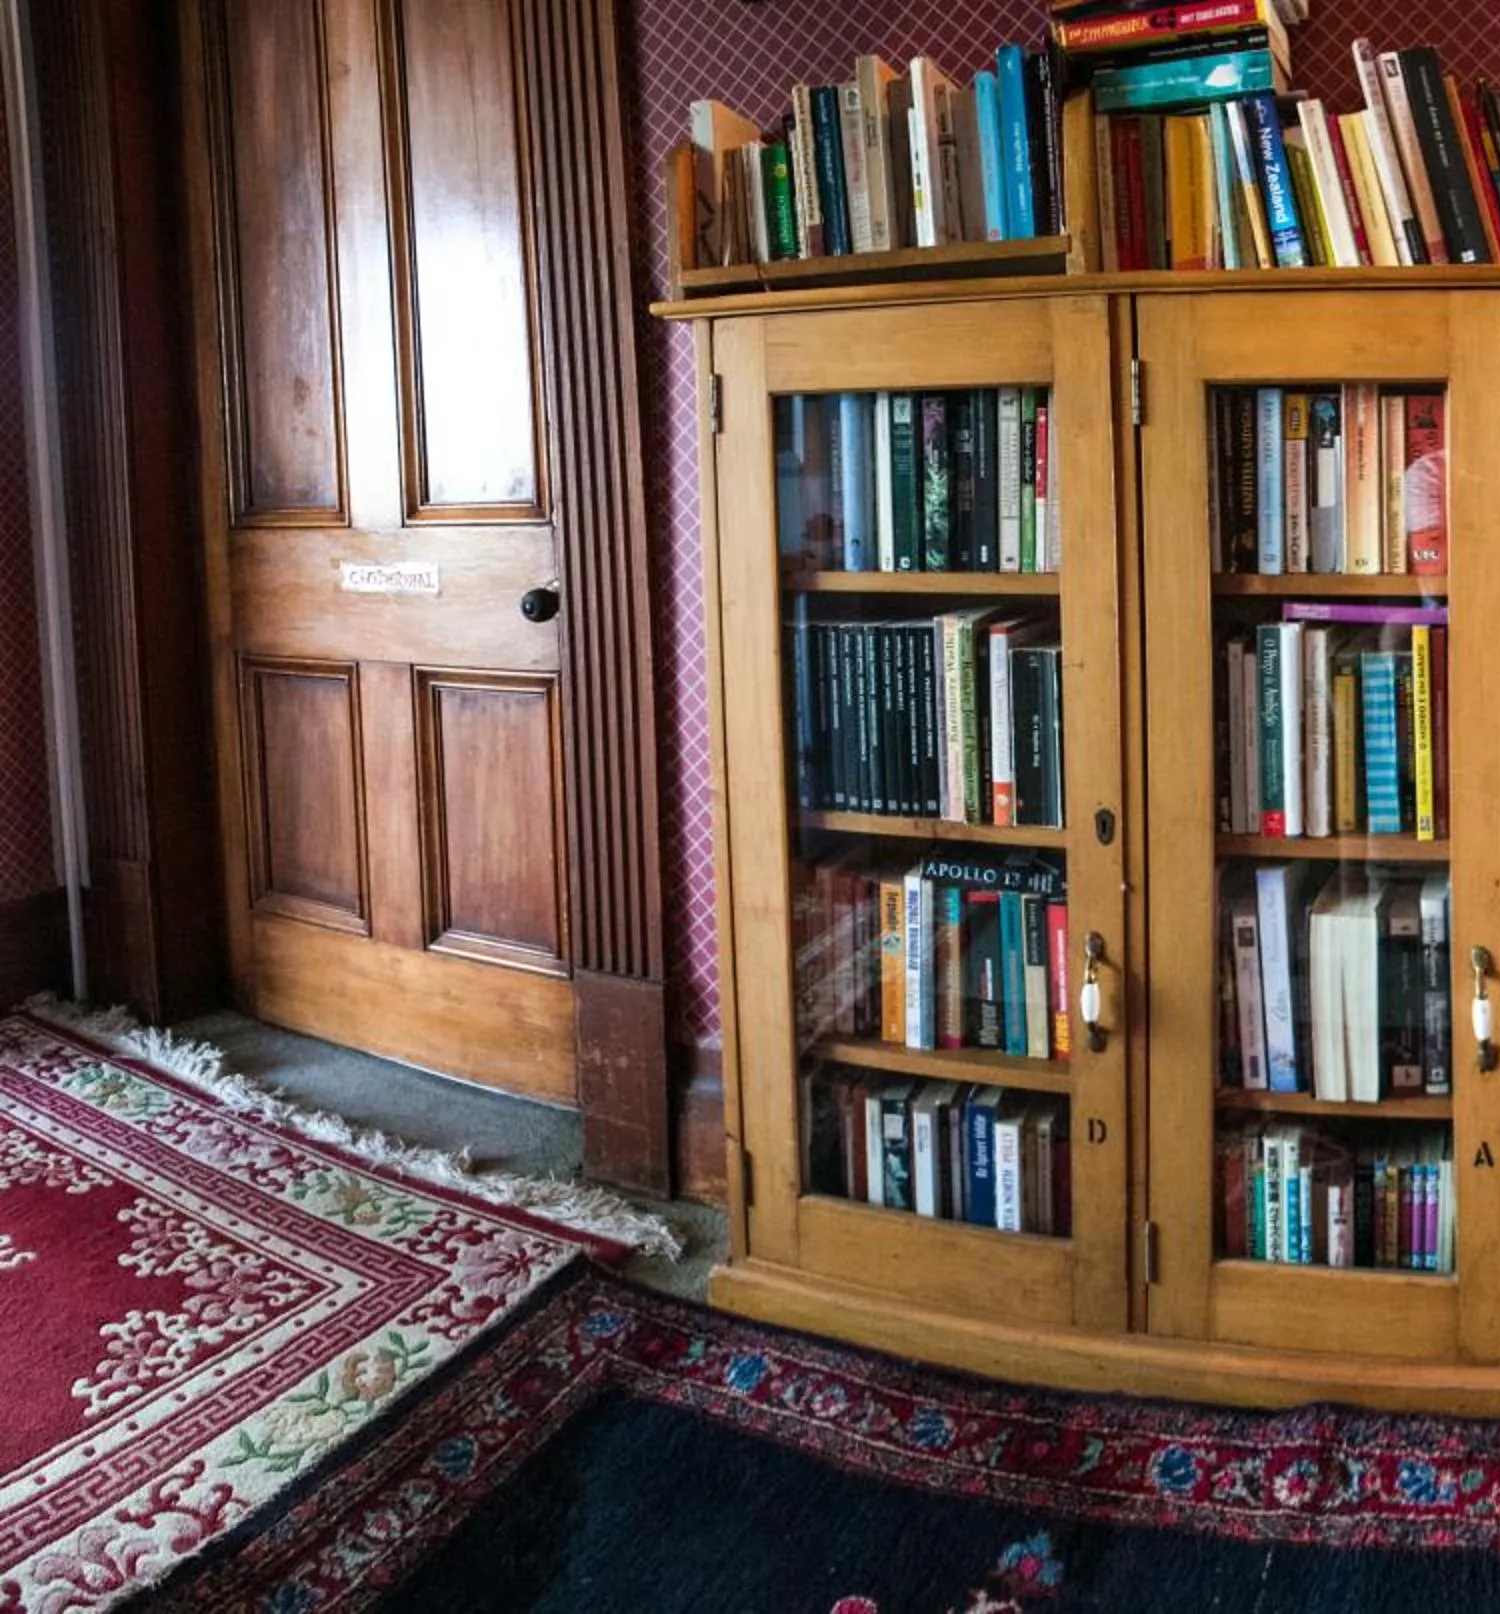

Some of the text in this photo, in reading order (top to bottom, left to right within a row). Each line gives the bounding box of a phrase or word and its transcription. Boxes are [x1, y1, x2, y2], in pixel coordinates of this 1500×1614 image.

[1258, 127, 1289, 223] New Zealand
[925, 861, 1021, 888] APOLLO 13
[1087, 1118, 1107, 1145] D
[1472, 1140, 1495, 1169] A
